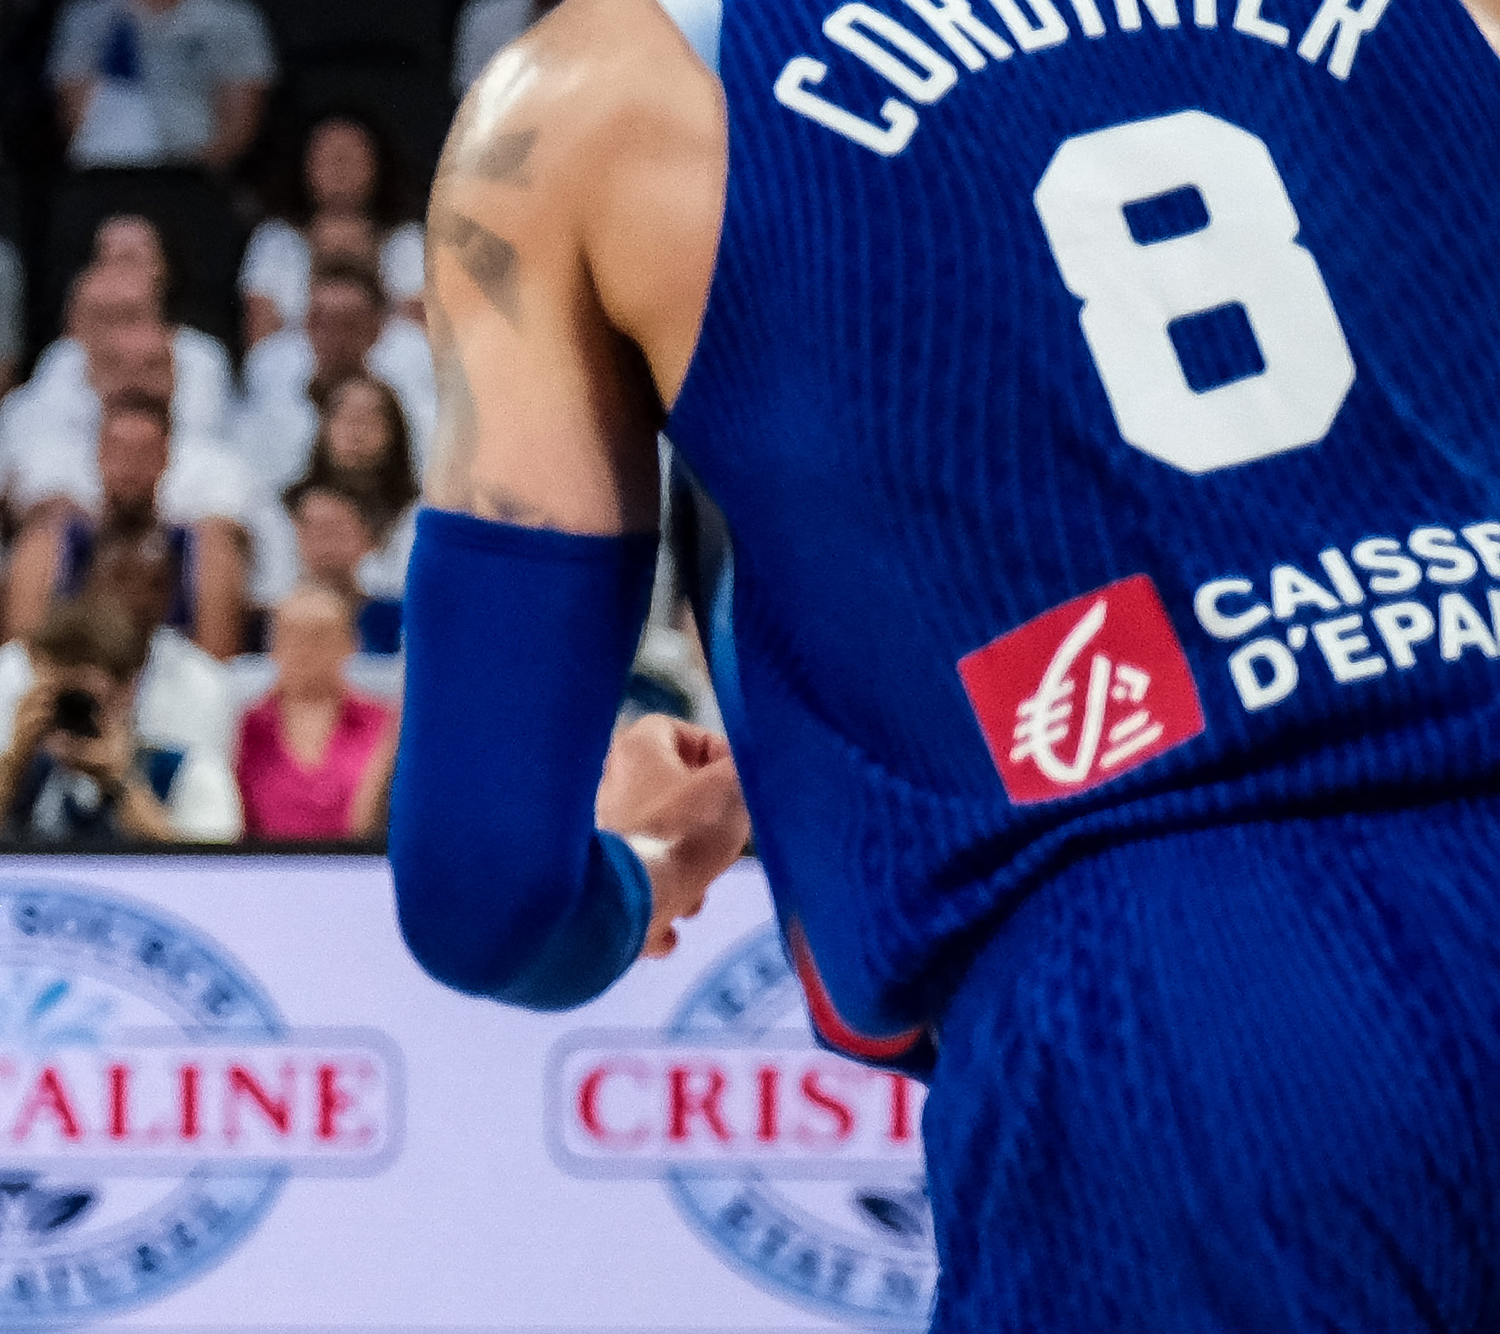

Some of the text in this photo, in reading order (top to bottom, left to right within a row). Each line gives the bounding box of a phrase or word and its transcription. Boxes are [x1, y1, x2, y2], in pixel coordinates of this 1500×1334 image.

[1032, 109, 1357, 475] 8
[1228, 589, 1500, 713] D'EPA
[575, 1053, 918, 1149] CRIST
